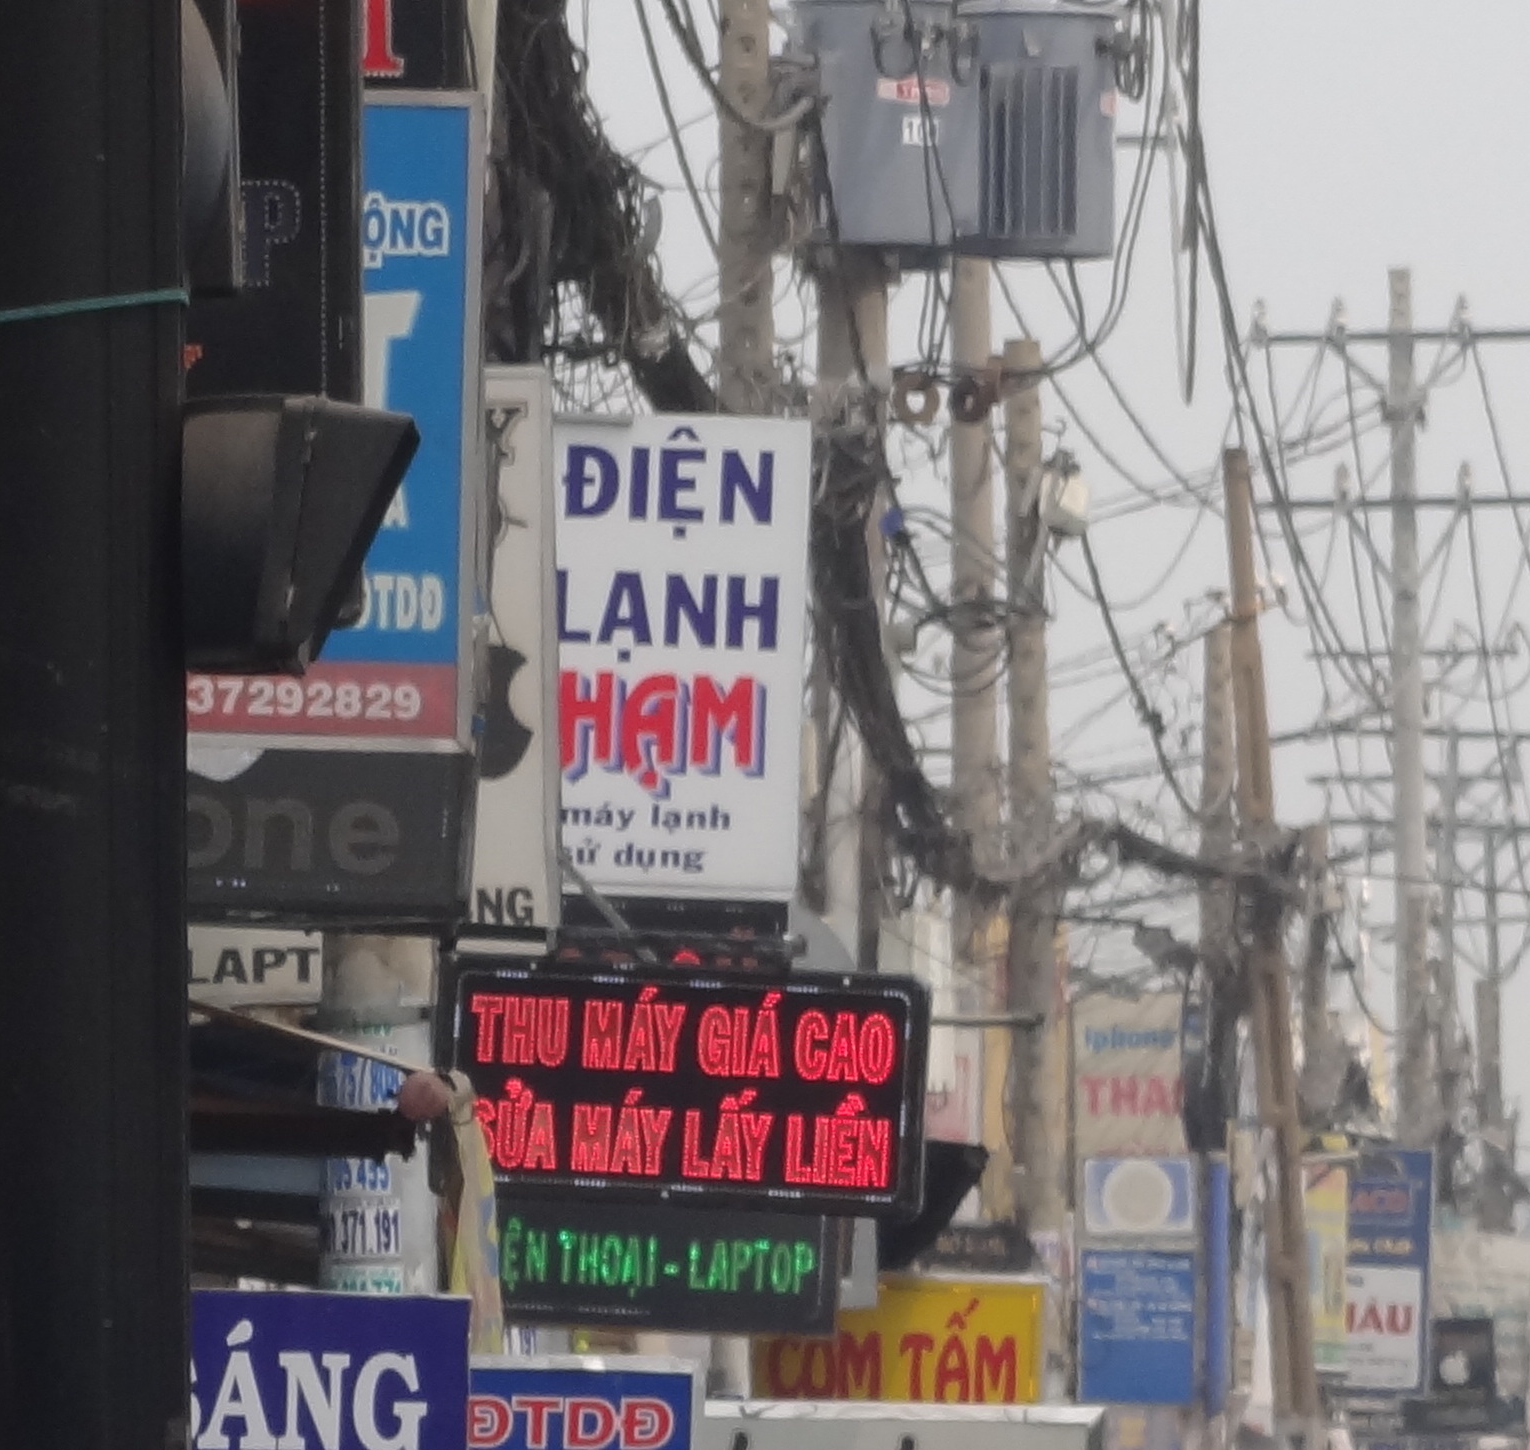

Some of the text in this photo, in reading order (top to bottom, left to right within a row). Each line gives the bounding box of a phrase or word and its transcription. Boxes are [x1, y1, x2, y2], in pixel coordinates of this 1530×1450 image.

[562, 425, 776, 539] ĐIỆN
[557, 569, 780, 662] LẠNH
[558, 802, 731, 835] máy lạnh
[613, 843, 705, 876] dụng
[472, 986, 897, 1085] THU MÁY GIÁ CAO
[571, 1088, 672, 1175] MÁY
[683, 1088, 771, 1184] LẤY
[558, 1229, 659, 1299] THOẠI
[688, 1237, 817, 1296] LAPTOP
[898, 1298, 1017, 1402] TẤM
